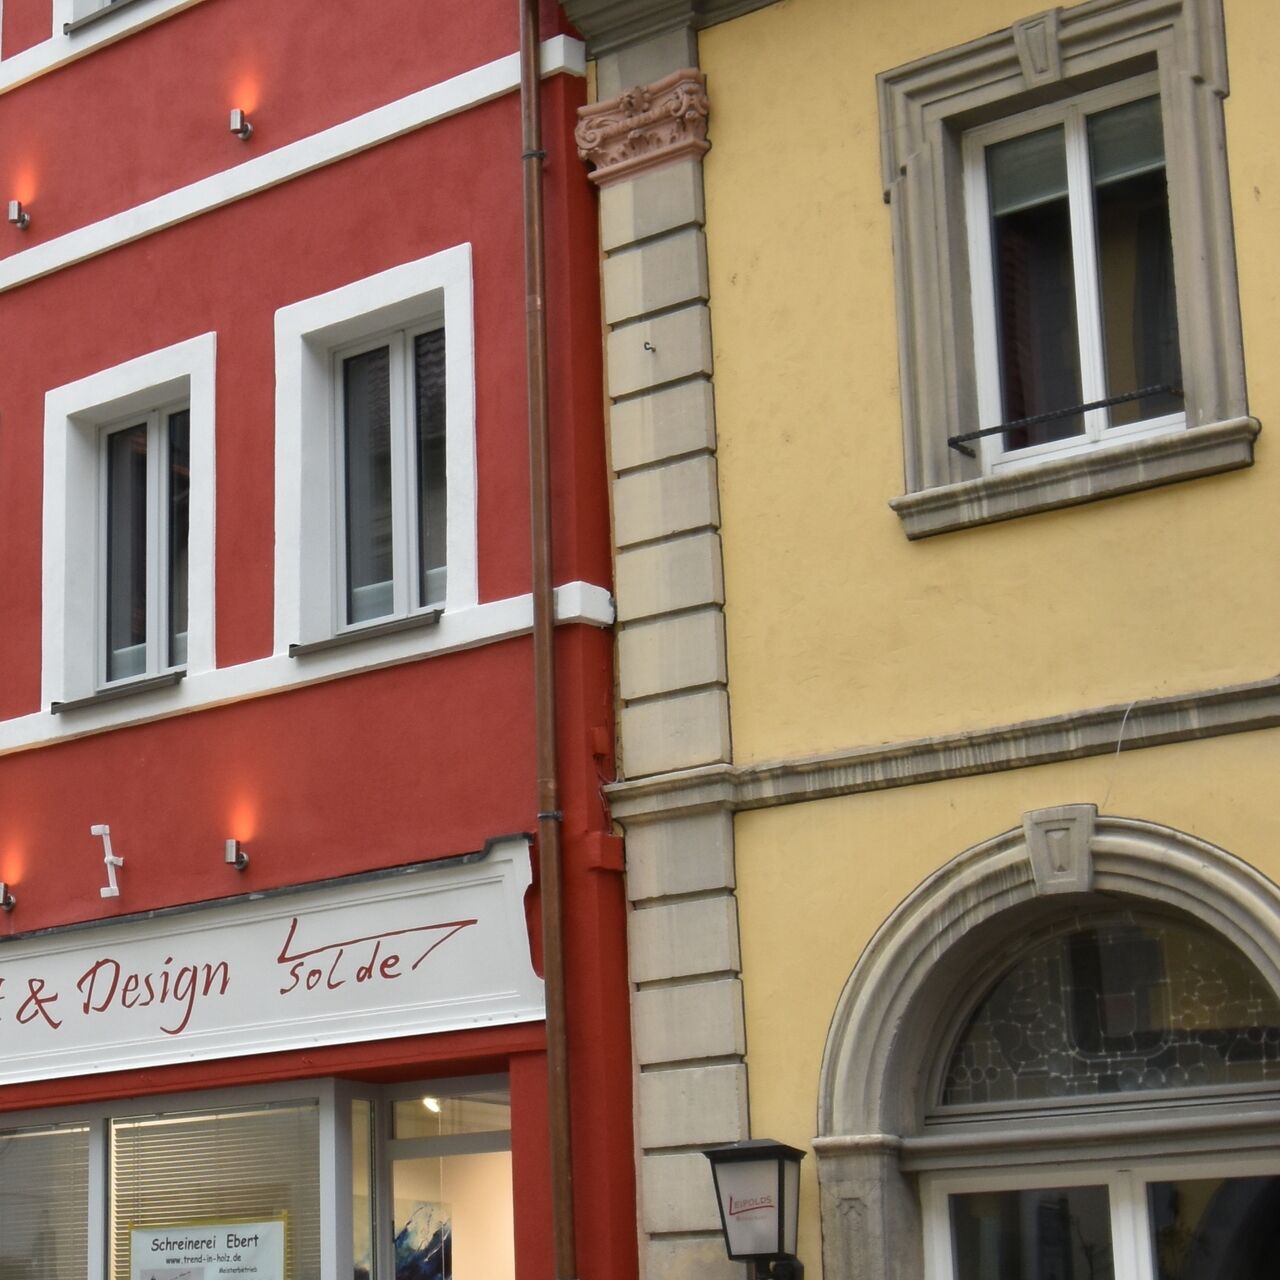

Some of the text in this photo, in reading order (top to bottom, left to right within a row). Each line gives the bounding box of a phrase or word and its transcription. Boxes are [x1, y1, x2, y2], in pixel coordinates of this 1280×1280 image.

[16, 976, 62, 1030] &
[76, 955, 232, 1036] Design
[150, 1233, 259, 1252] Schreinerei Ebert
[165, 1253, 242, 1265] www.trend-in-holz.de
